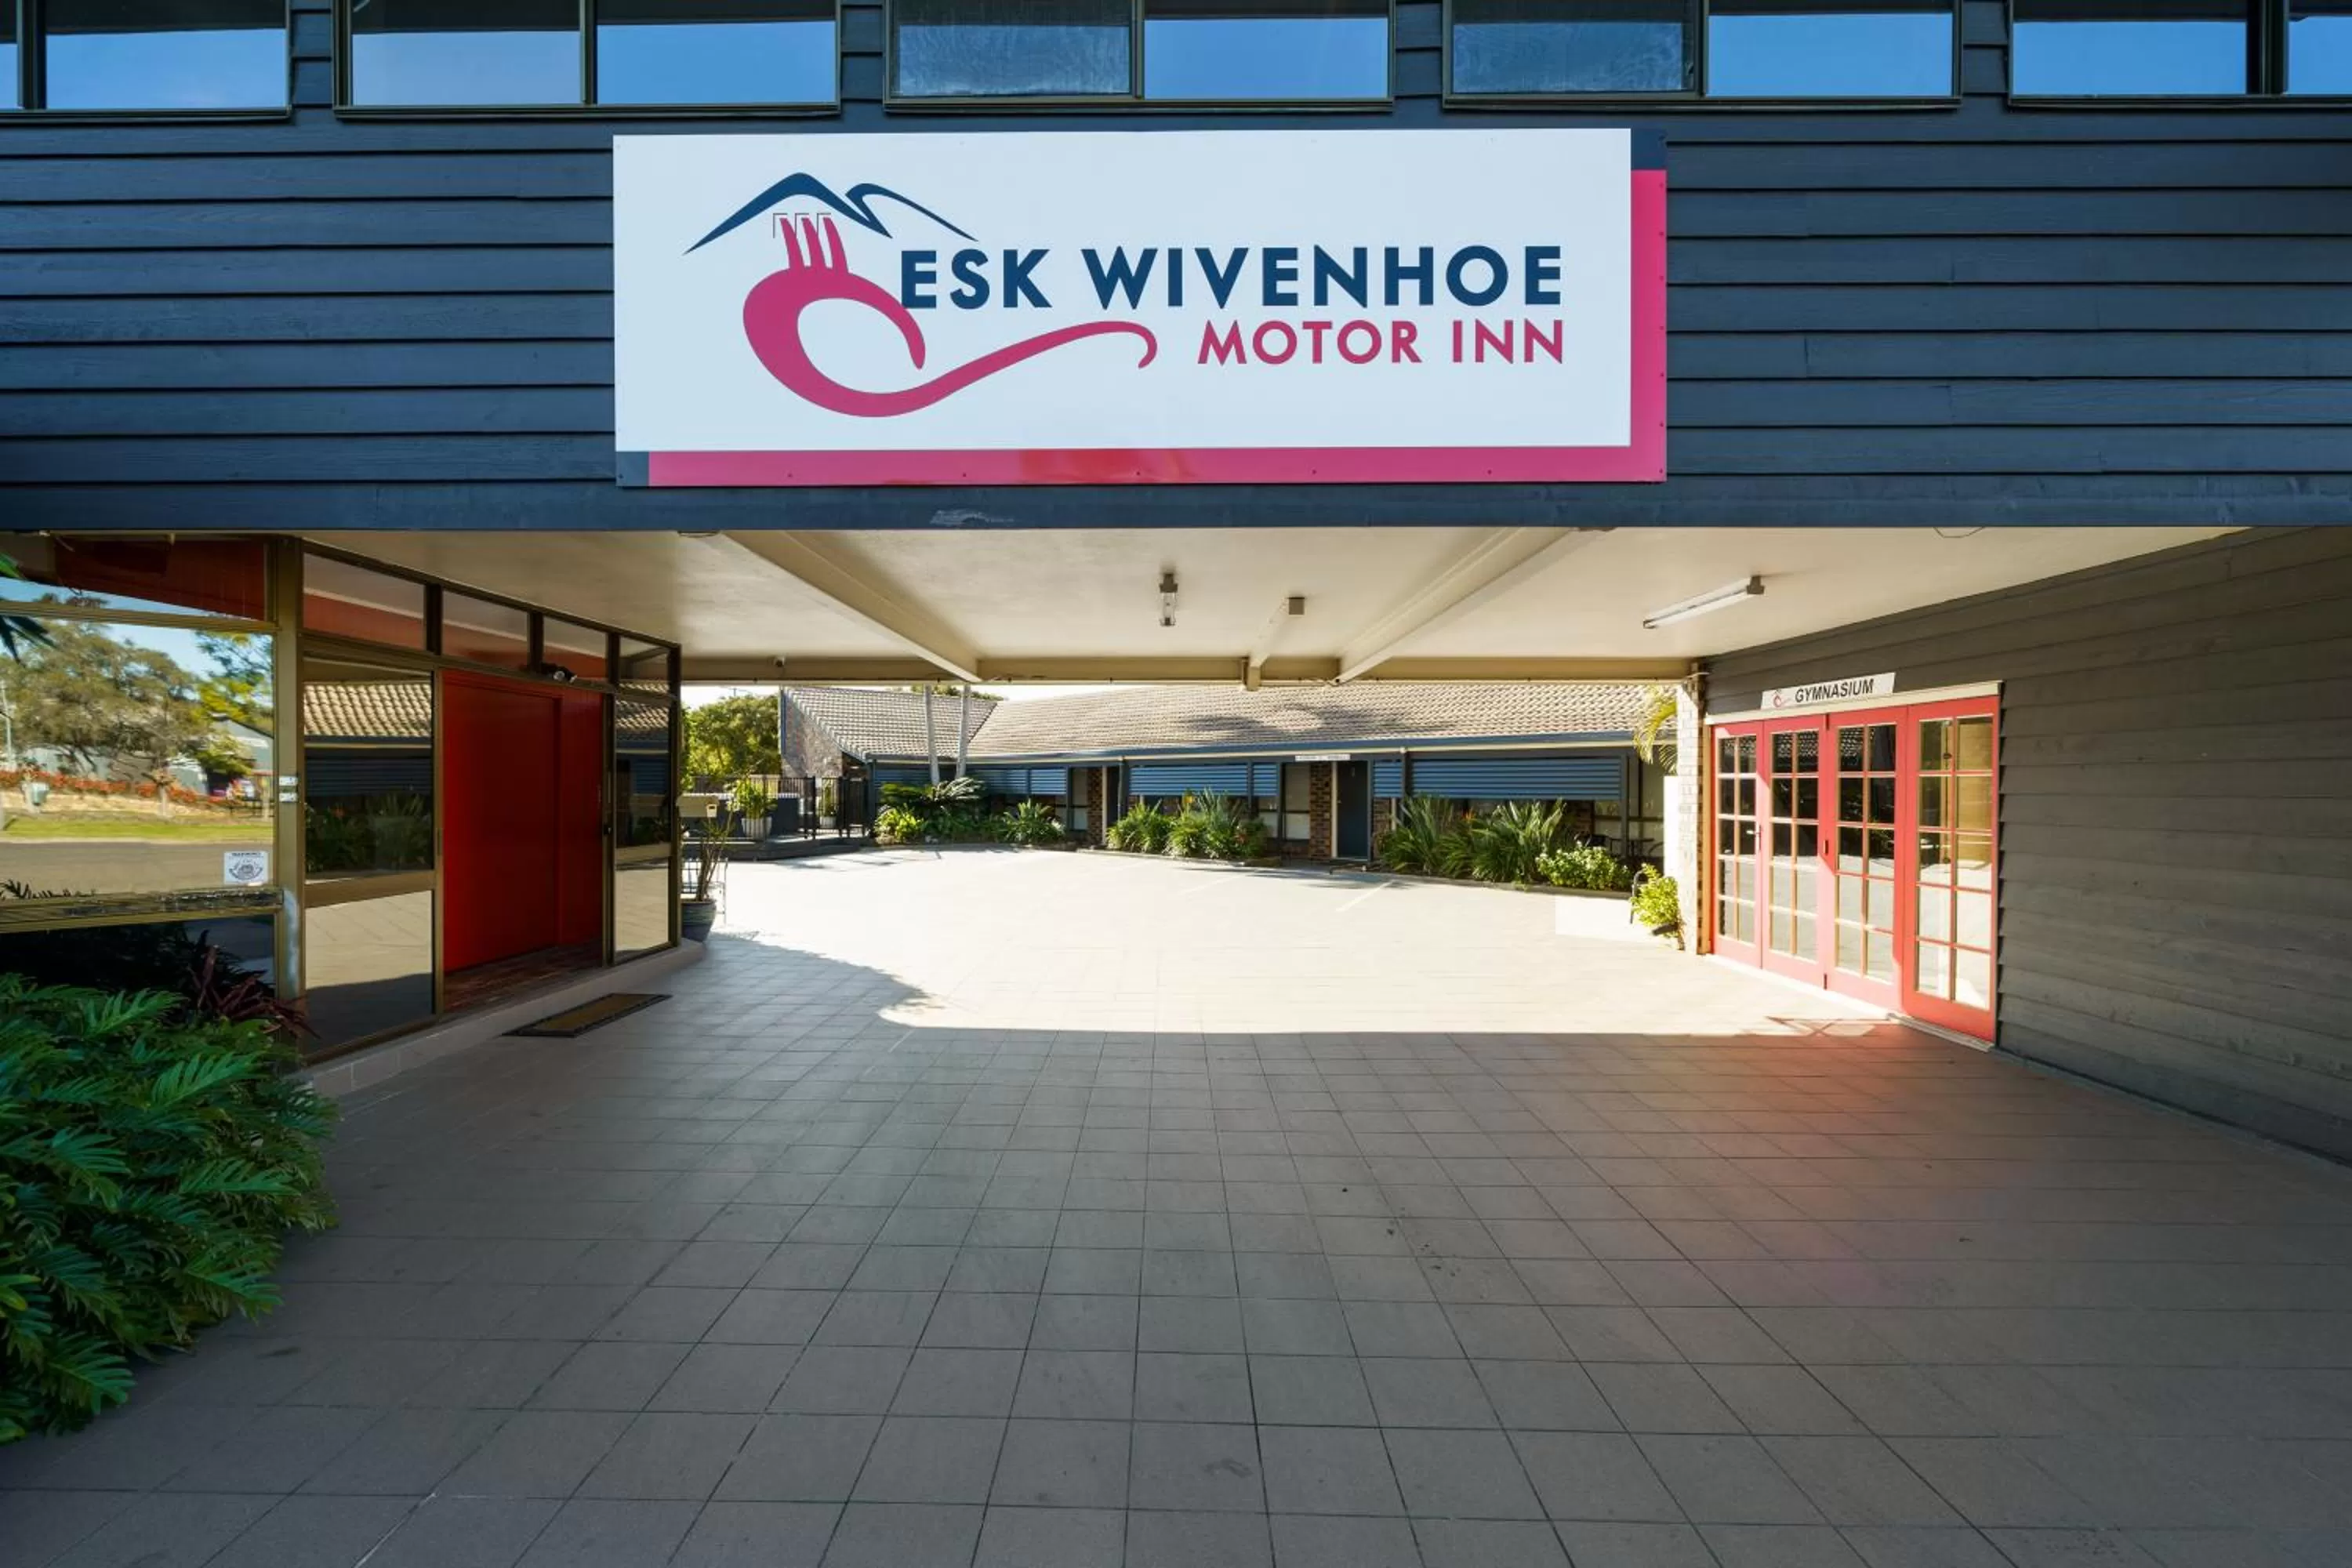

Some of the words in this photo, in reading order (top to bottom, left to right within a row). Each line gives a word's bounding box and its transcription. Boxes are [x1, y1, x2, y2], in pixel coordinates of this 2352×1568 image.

[901, 249, 1053, 310] ESK
[1081, 245, 1562, 310] WIVENHOE
[1197, 320, 1422, 365] MOTOR
[1453, 318, 1563, 365] INN
[1795, 678, 1875, 702] GYMNASIUM
